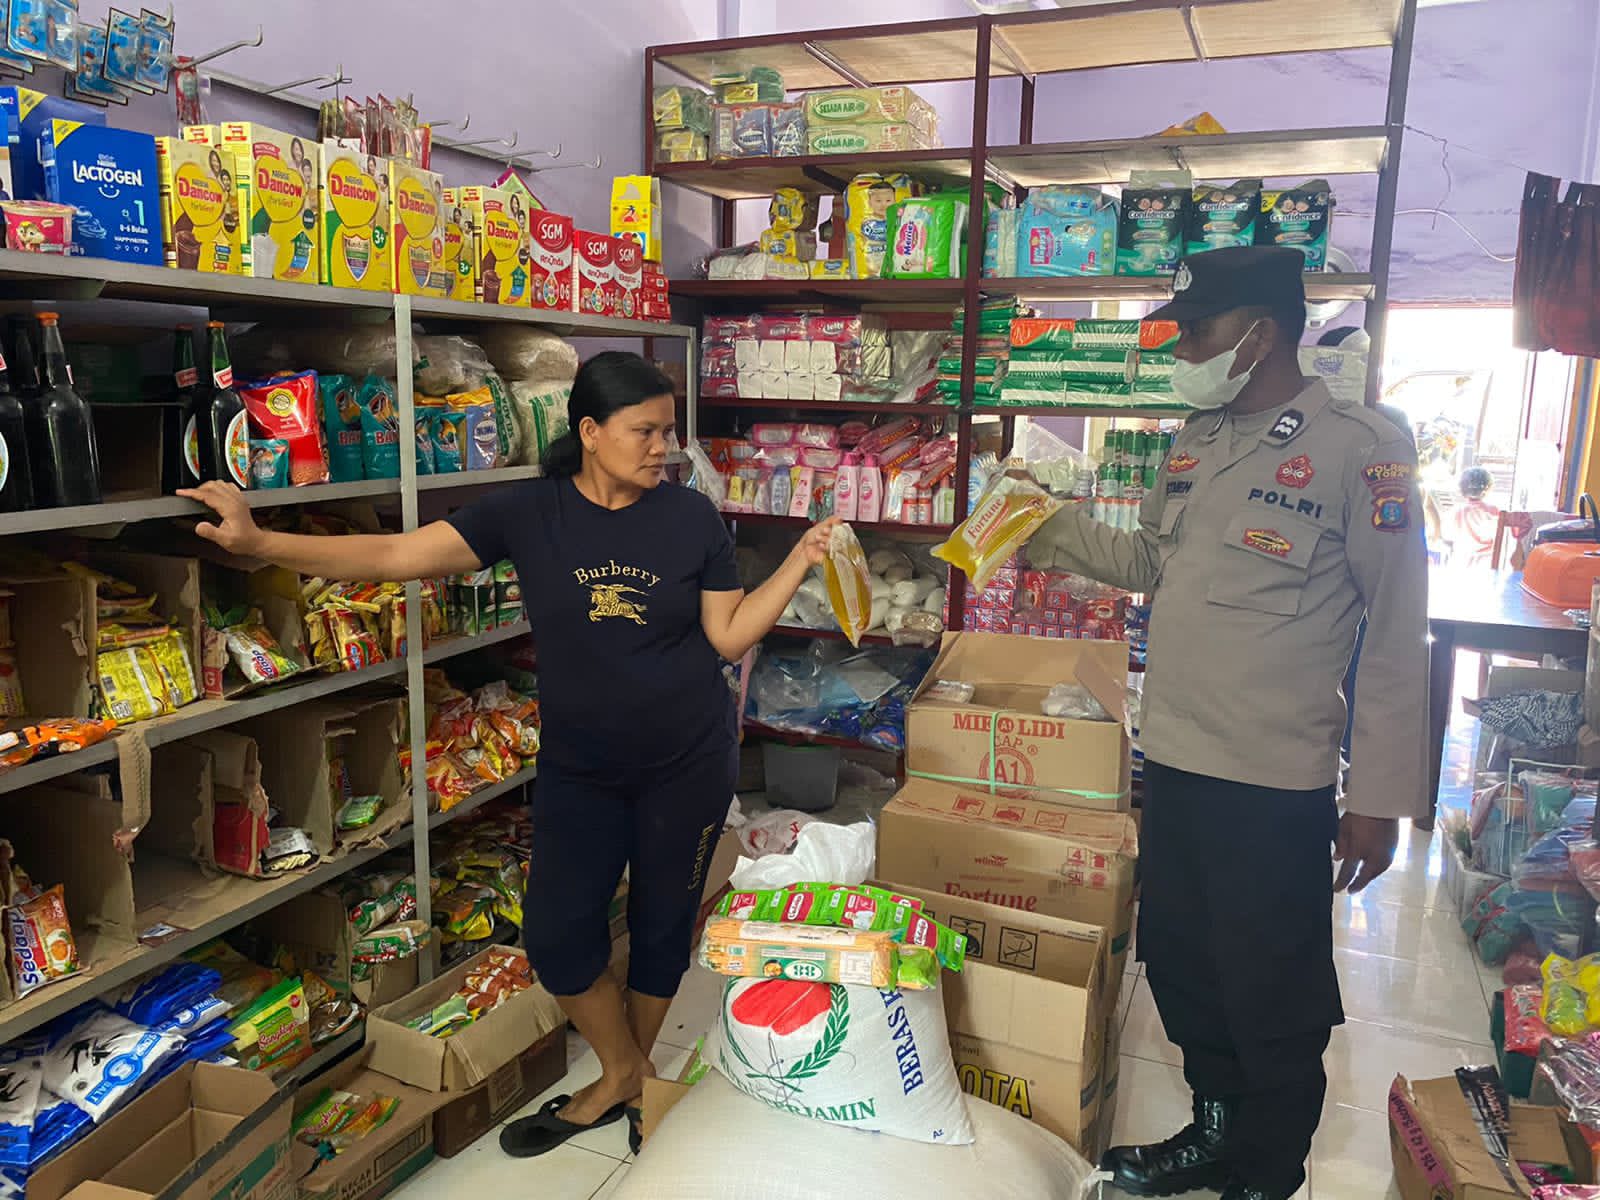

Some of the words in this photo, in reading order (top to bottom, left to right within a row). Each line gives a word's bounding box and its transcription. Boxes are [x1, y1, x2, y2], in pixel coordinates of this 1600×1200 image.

[72, 160, 144, 187] LACTOGEN
[258, 168, 303, 198] Dancow
[179, 177, 222, 204] Dancow
[330, 175, 377, 203] Dancow
[399, 190, 436, 217] Dancow
[1128, 210, 1176, 219] Confidence
[486, 220, 519, 240] Dancow
[1269, 212, 1323, 223] Confidence
[374, 229, 385, 246] 3+
[541, 224, 563, 240] SGM
[588, 242, 608, 256] SGM
[619, 249, 635, 262] SGM
[1248, 487, 1322, 519] POLRI
[573, 560, 661, 587] Burberry
[952, 712, 991, 733] MIE
[1018, 719, 1065, 739] LIDI
[994, 735, 1023, 748] CAP
[994, 759, 1019, 785] A1
[888, 1006, 924, 1096] BERAS
[956, 1063, 1033, 1120] OTA
